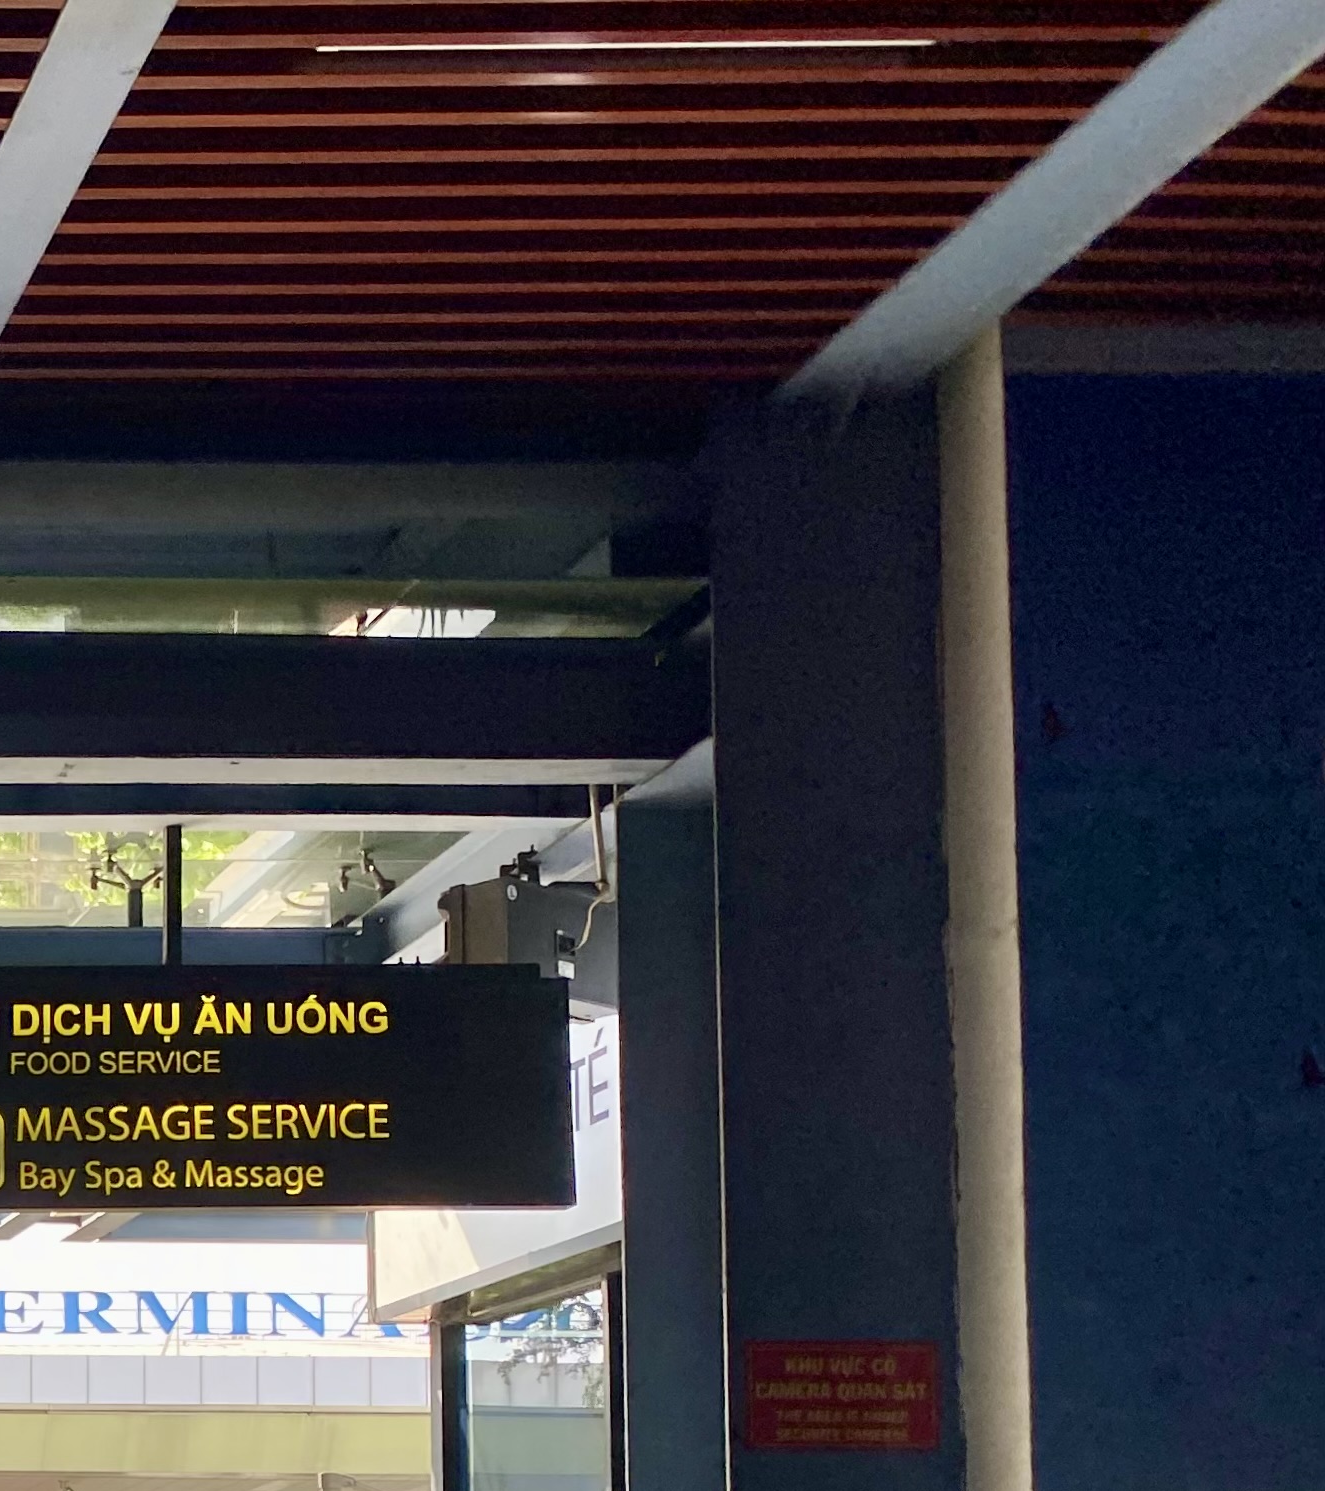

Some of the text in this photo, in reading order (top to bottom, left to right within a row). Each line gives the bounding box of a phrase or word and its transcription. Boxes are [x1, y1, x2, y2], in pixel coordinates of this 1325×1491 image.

[12, 994, 389, 1042] DỊCH VỤ ĂN UỐNG
[10, 1050, 221, 1076] FOOD SERVICE
[16, 1103, 390, 1142] MASSAGE SERVICE
[19, 1160, 324, 1196] Bay Spa & Massage
